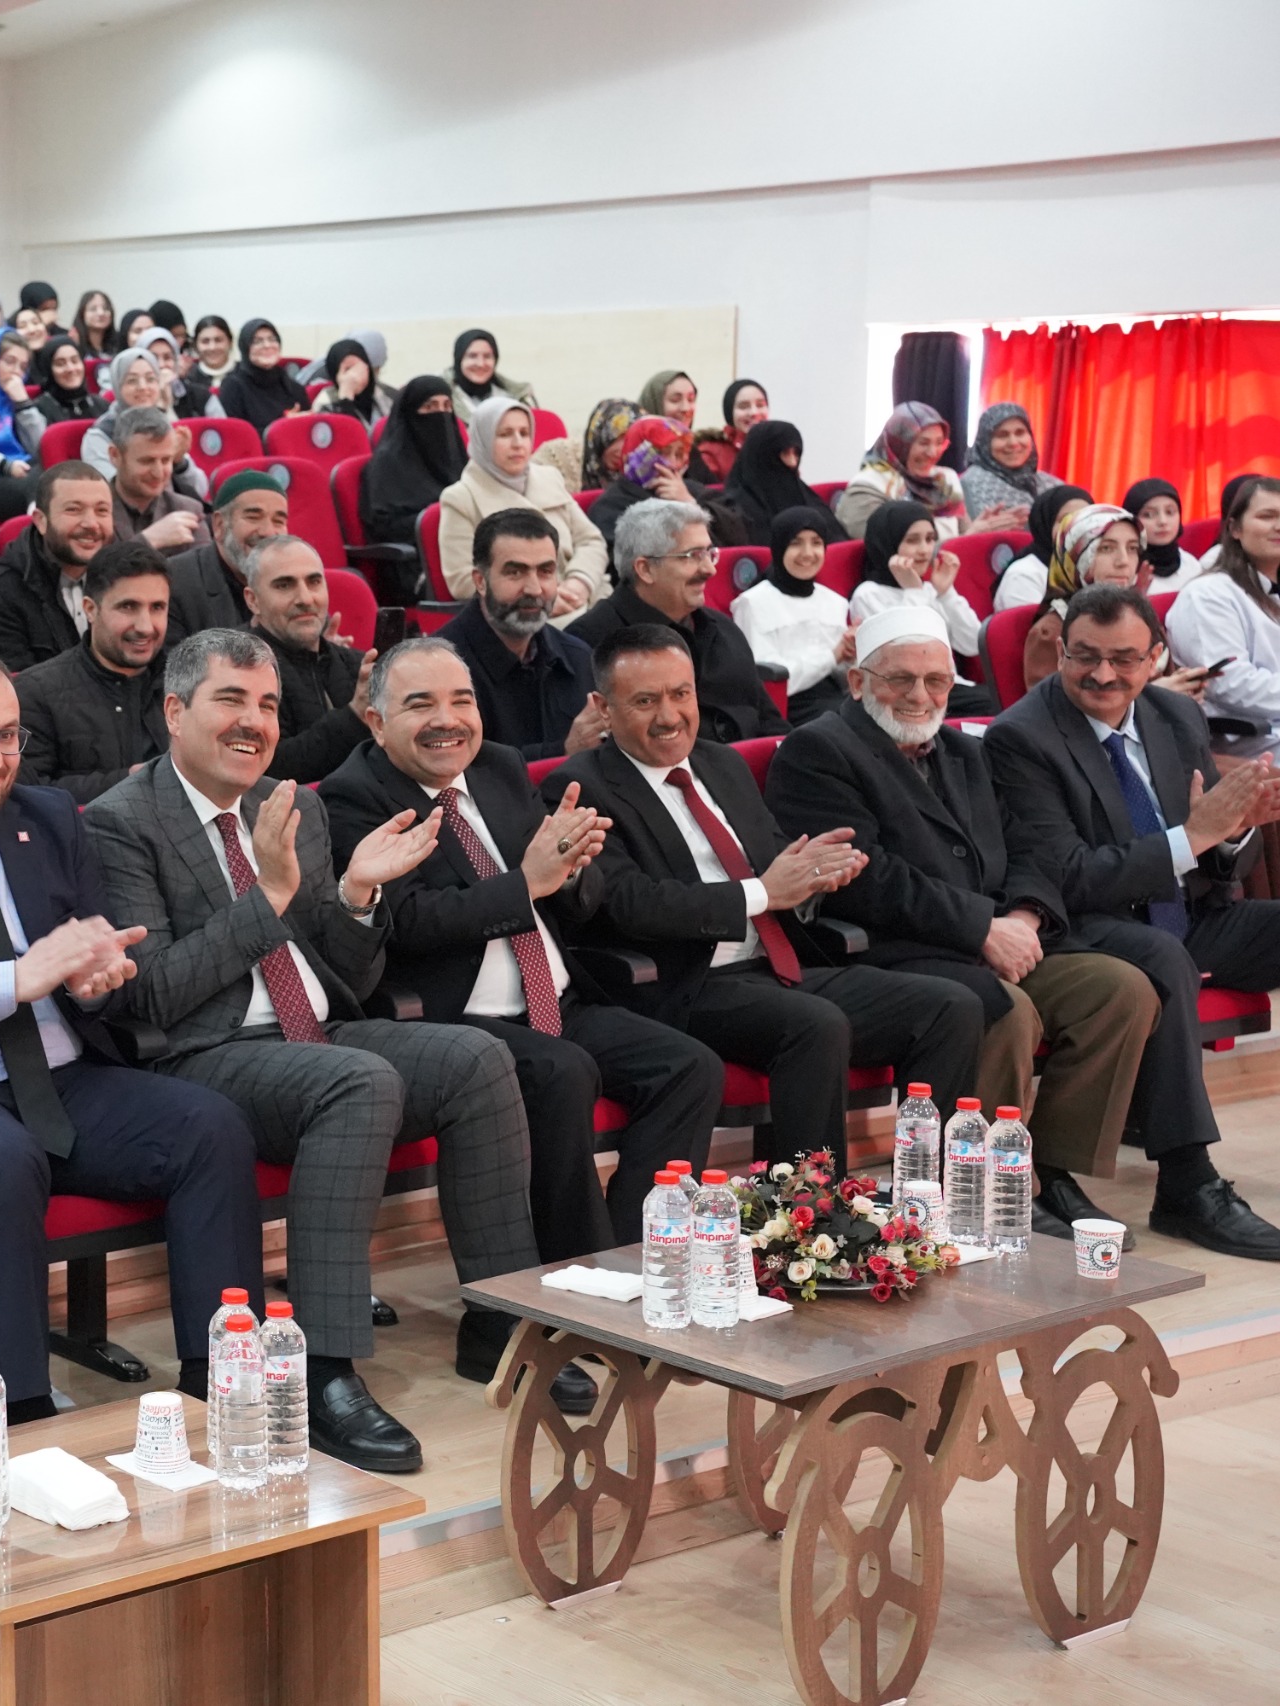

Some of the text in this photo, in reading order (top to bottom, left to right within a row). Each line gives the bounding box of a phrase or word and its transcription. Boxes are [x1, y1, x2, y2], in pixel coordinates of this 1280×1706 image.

[650, 1232, 689, 1245] binpınar
[694, 1231, 734, 1242] binpınar
[145, 1405, 171, 1416] Coffee
[145, 1415, 171, 1426] Kakao
